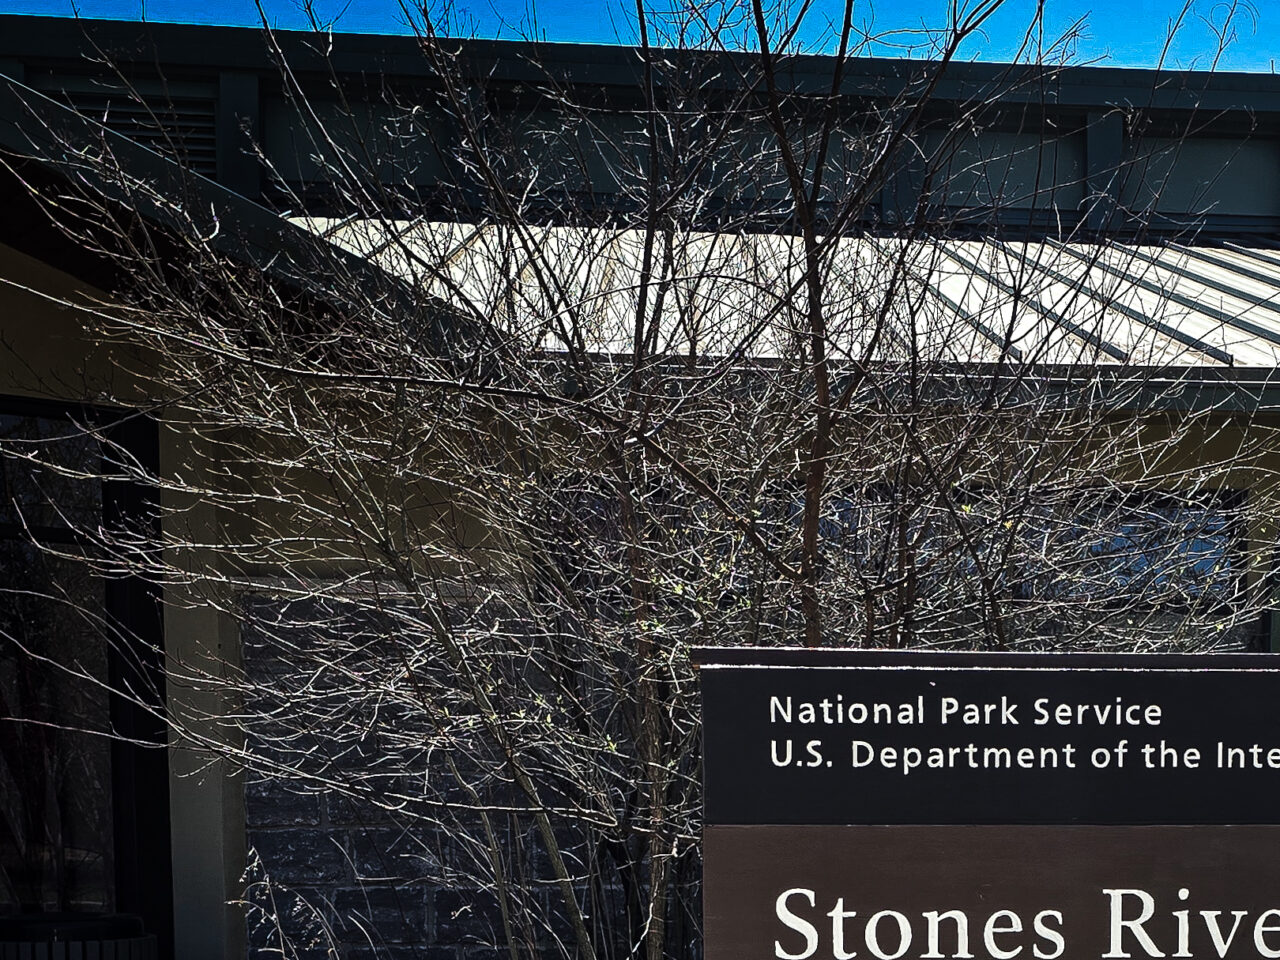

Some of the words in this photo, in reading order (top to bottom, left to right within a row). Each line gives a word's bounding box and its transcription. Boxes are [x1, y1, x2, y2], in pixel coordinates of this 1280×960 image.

[770, 694, 924, 725] National
[941, 696, 1020, 725] Park
[1033, 697, 1163, 726] Service
[770, 740, 833, 768] U.S.
[851, 741, 1076, 776] Department
[1091, 740, 1128, 769] of
[1140, 740, 1201, 769] the
[774, 888, 1065, 960] Stones
